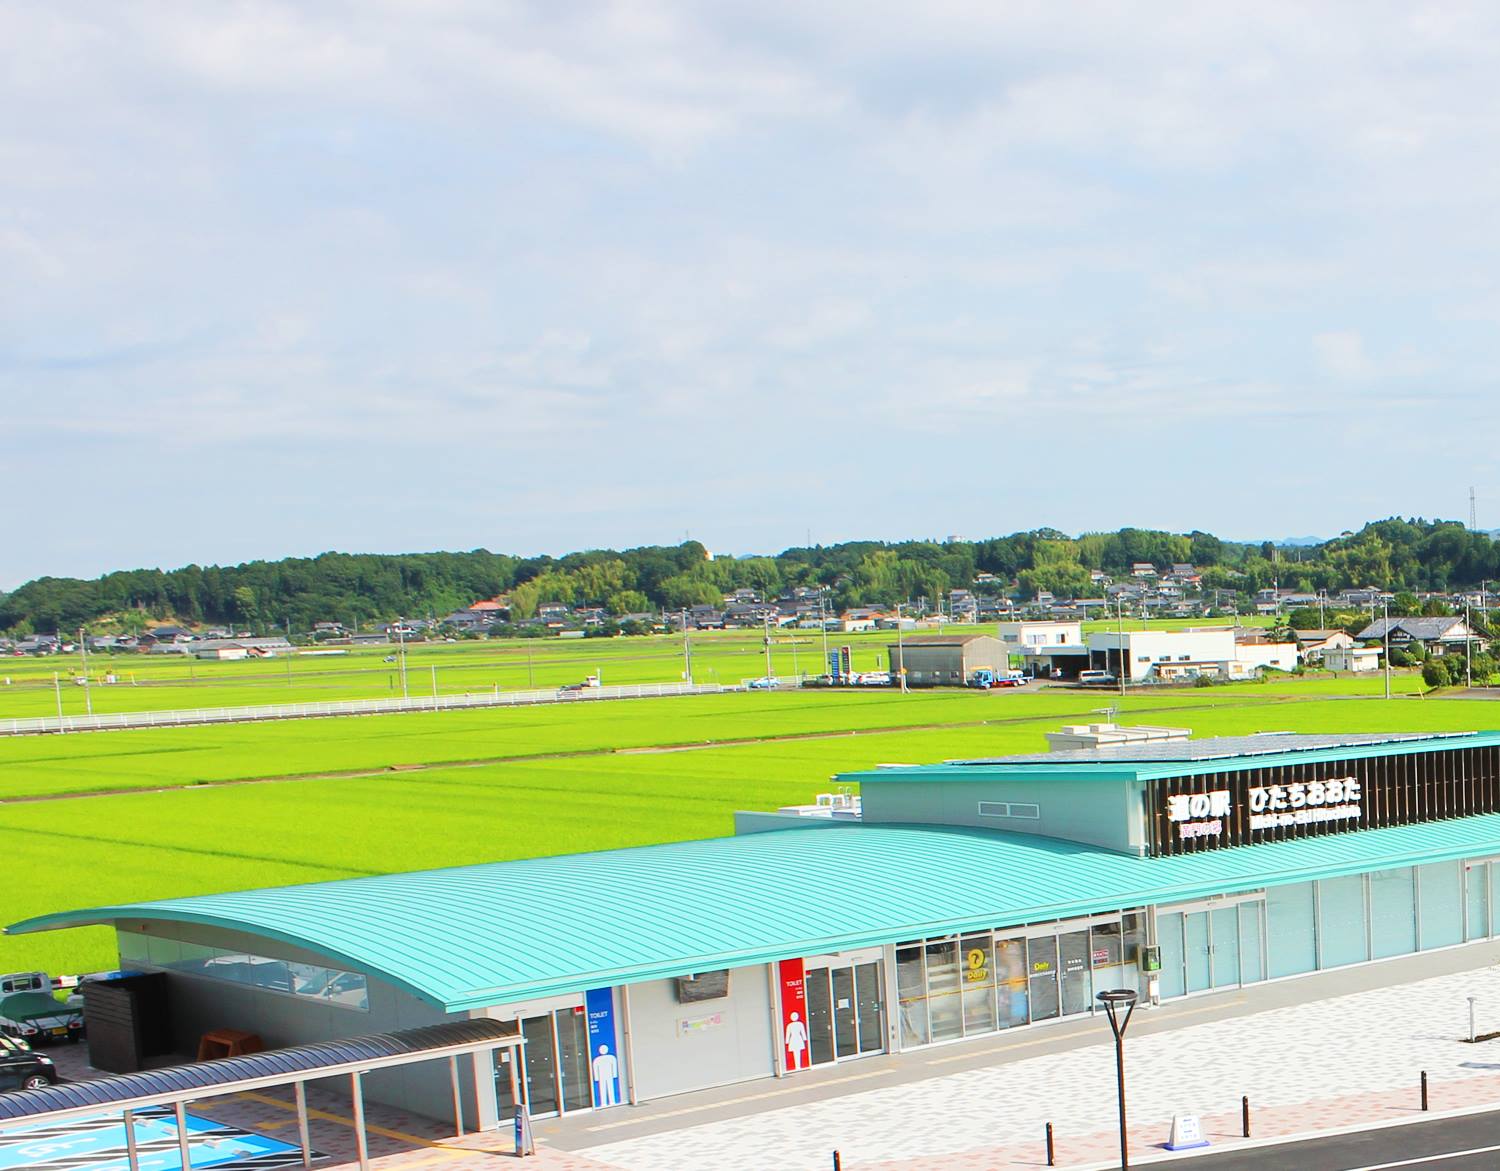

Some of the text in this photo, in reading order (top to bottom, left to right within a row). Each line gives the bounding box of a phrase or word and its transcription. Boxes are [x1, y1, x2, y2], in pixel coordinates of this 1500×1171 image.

[1168, 777, 1361, 821] 道の駅 ひたちおおた
[590, 1011, 608, 1019] TOILET
